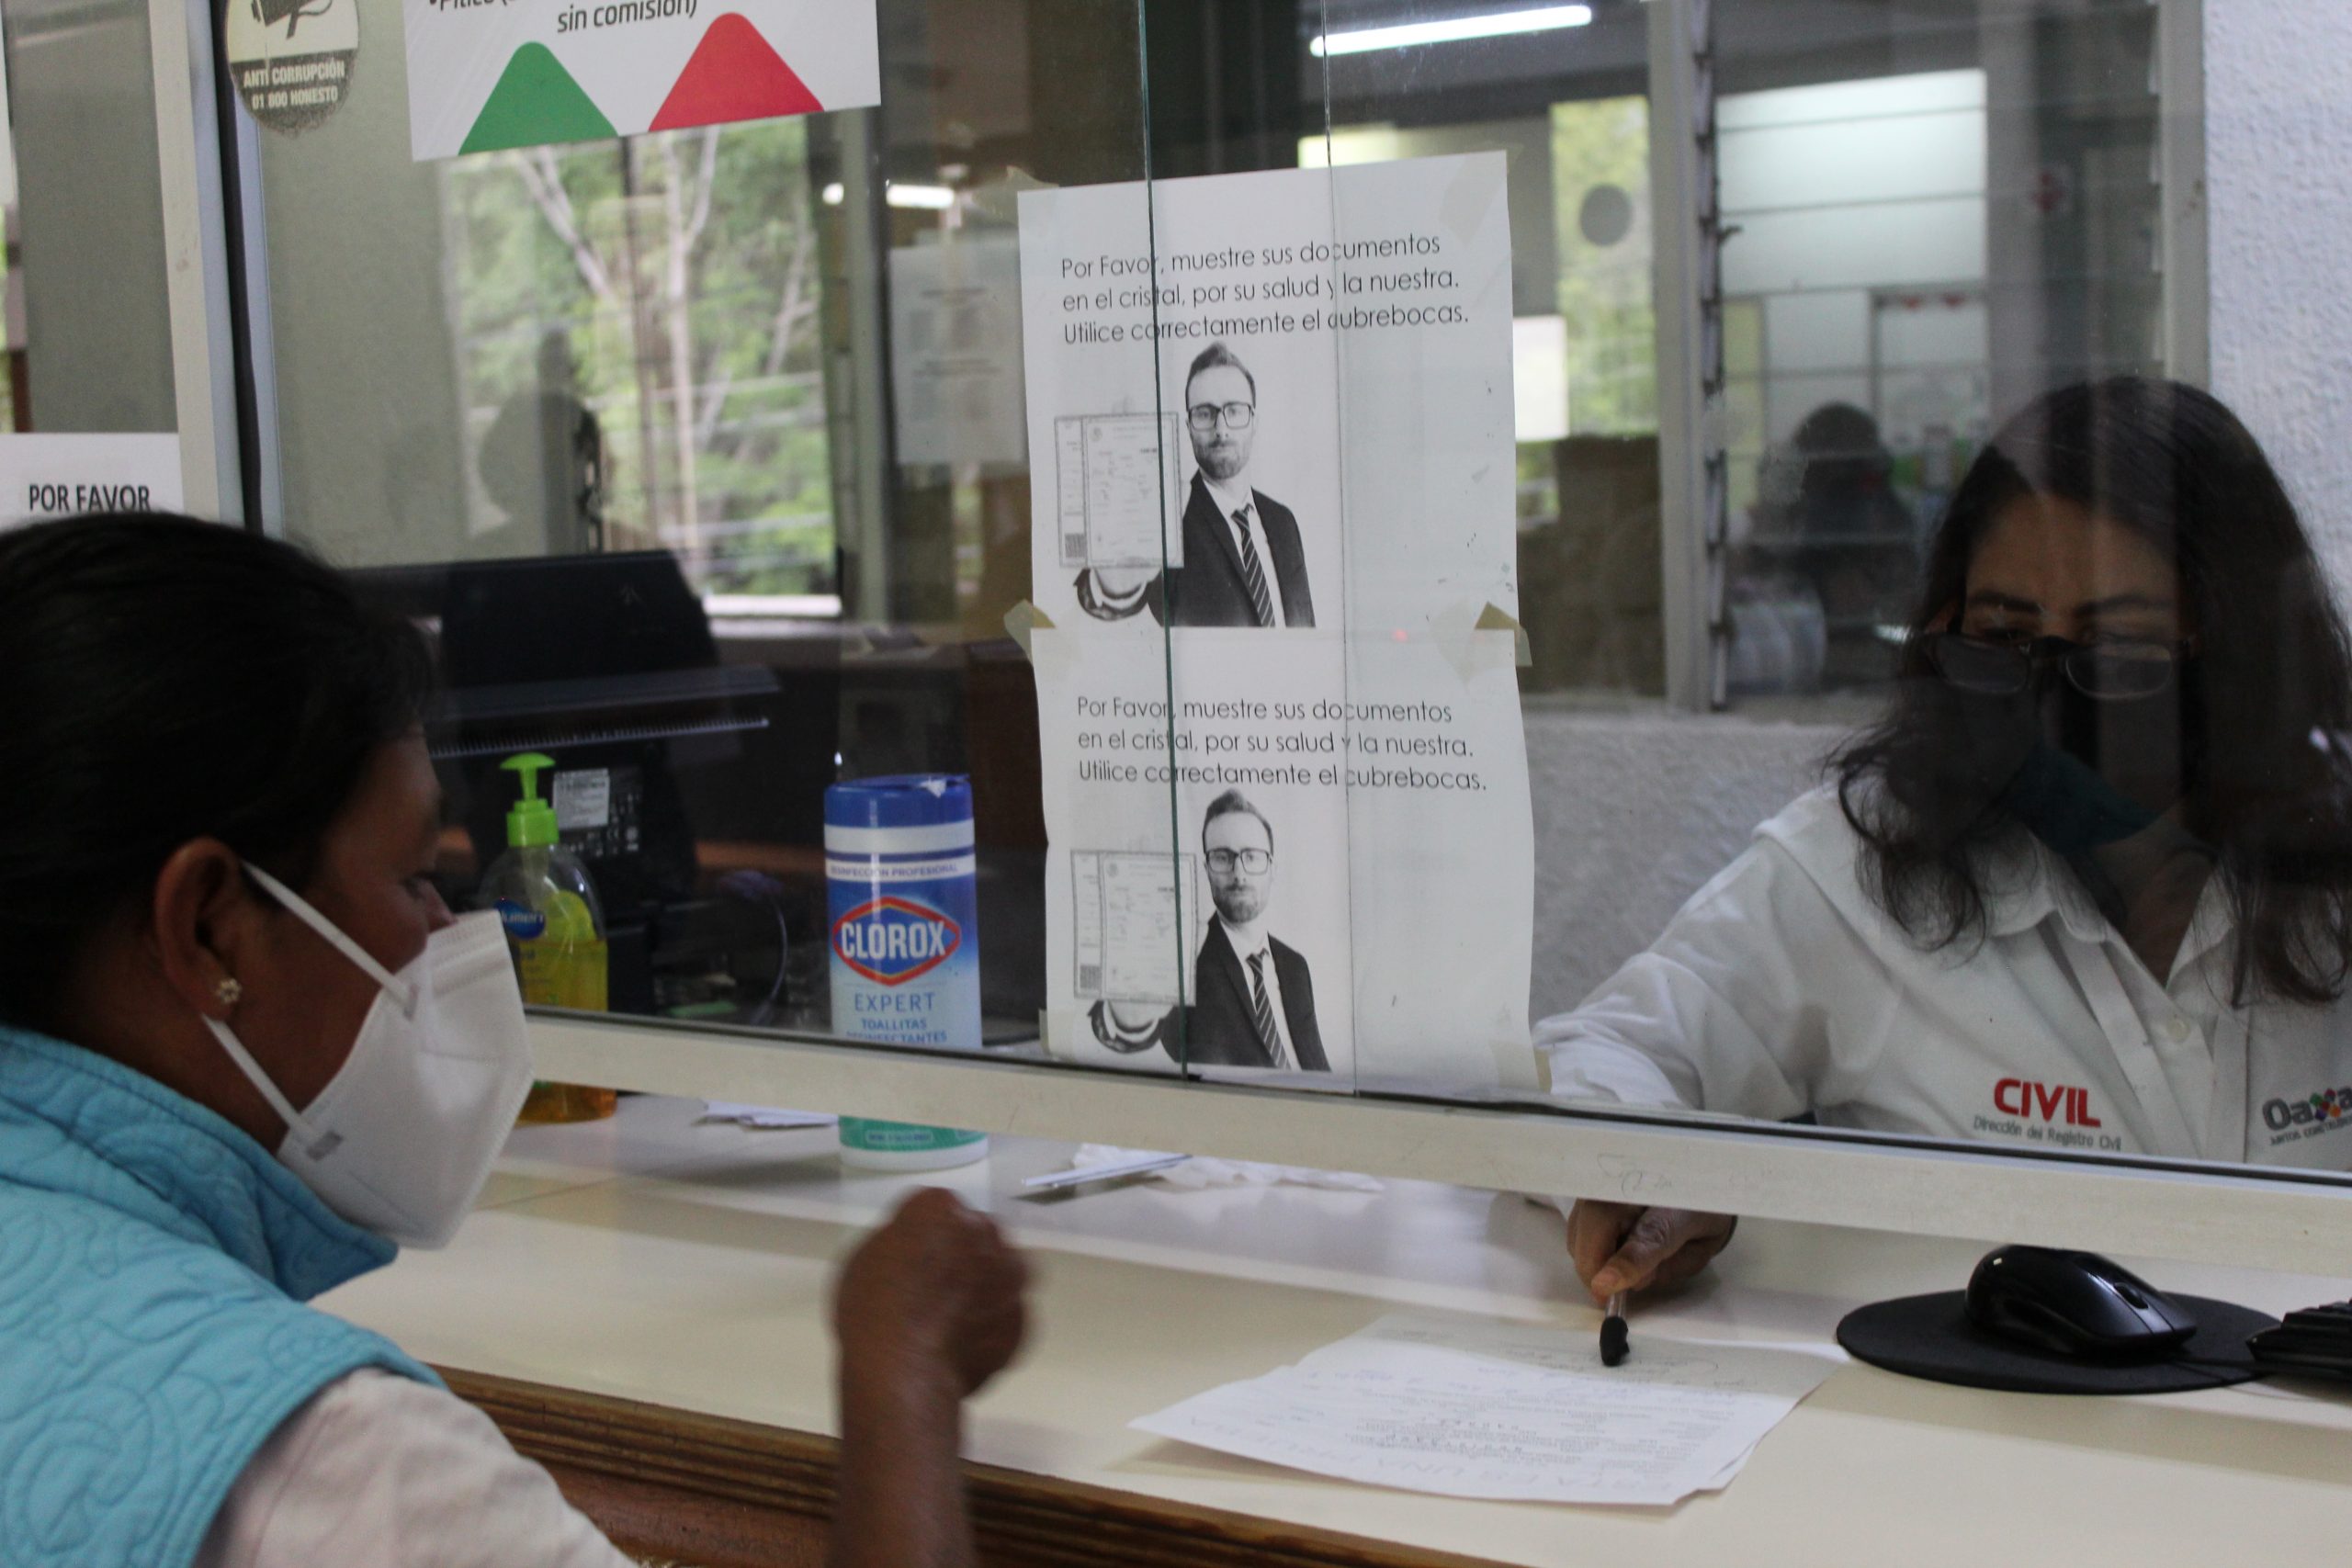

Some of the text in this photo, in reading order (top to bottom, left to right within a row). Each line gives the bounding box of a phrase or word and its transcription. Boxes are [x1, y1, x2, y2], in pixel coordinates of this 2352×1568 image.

[557, 4, 587, 33] sin
[243, 57, 345, 88] ANTI CORRUPCIÓN
[252, 85, 338, 110] 01 800 HONESTO
[1061, 257, 1093, 278] Por
[1171, 246, 1255, 272] muestre
[1261, 246, 1293, 266] sus
[1300, 233, 1441, 264] documentos
[1063, 293, 1089, 312] en
[1095, 288, 1113, 310] el
[1119, 284, 1186, 309] cristal,
[1193, 285, 1227, 309] por
[1234, 283, 1256, 302] su
[1262, 275, 1319, 299] salud
[1343, 272, 1363, 294] la
[1371, 267, 1460, 292] nuestra.
[1064, 303, 1469, 345] Utilice correctamente el cubrebocas.
[29, 483, 151, 513] POR FAVOR
[1078, 696, 1453, 723] Por Favor, muestre sus documentos
[1078, 732, 1102, 749] en
[1109, 728, 1125, 750] el
[1131, 728, 1198, 752] cristal,
[1205, 734, 1241, 756] por
[1248, 734, 1270, 752] su
[1276, 731, 1335, 753] salud
[1358, 731, 1379, 754] la
[1385, 734, 1474, 757] nuestra.
[1079, 760, 1487, 791] Utilice correctamente el cubrebocas.
[841, 920, 946, 960] CLOROX
[854, 992, 935, 1012] EXPERT
[861, 1017, 928, 1030] TOALLITAS
[1994, 1077, 2101, 1128] CIVIL
[1973, 1114, 2021, 1135] Dirección
[2027, 1124, 2042, 1141] del
[2048, 1127, 2094, 1147] Registro
